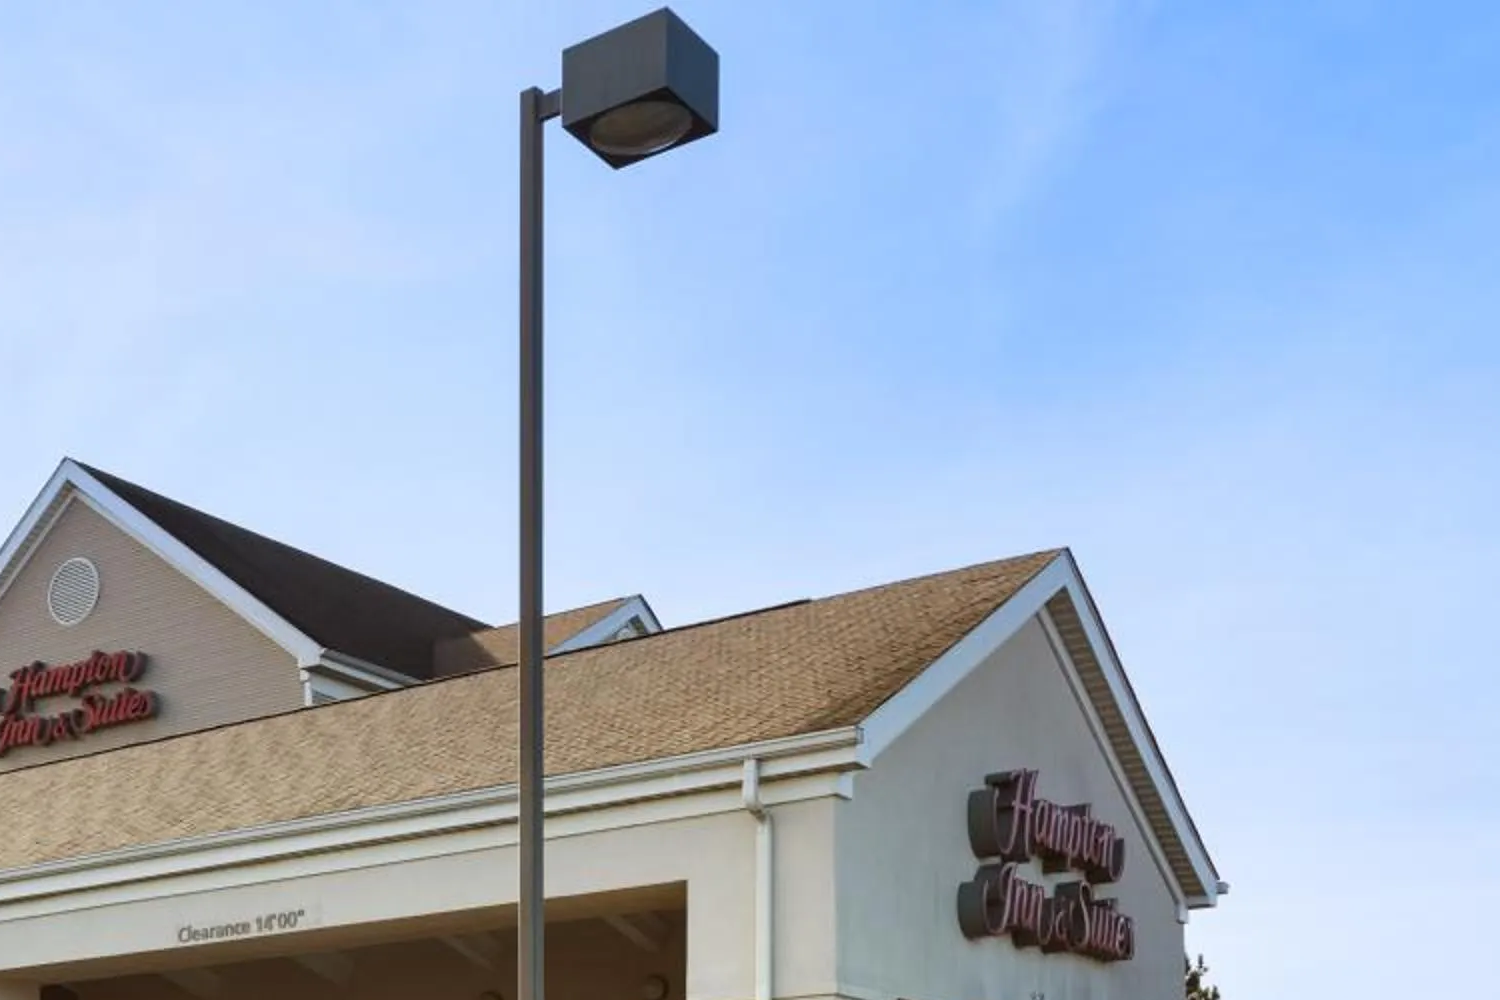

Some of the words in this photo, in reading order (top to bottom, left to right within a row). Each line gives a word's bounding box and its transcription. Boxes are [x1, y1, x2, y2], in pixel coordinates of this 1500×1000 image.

[70, 686, 162, 735] Suites
[968, 768, 1124, 884] Hampton
[178, 921, 251, 942] Clearance
[958, 862, 1054, 948] Inn
